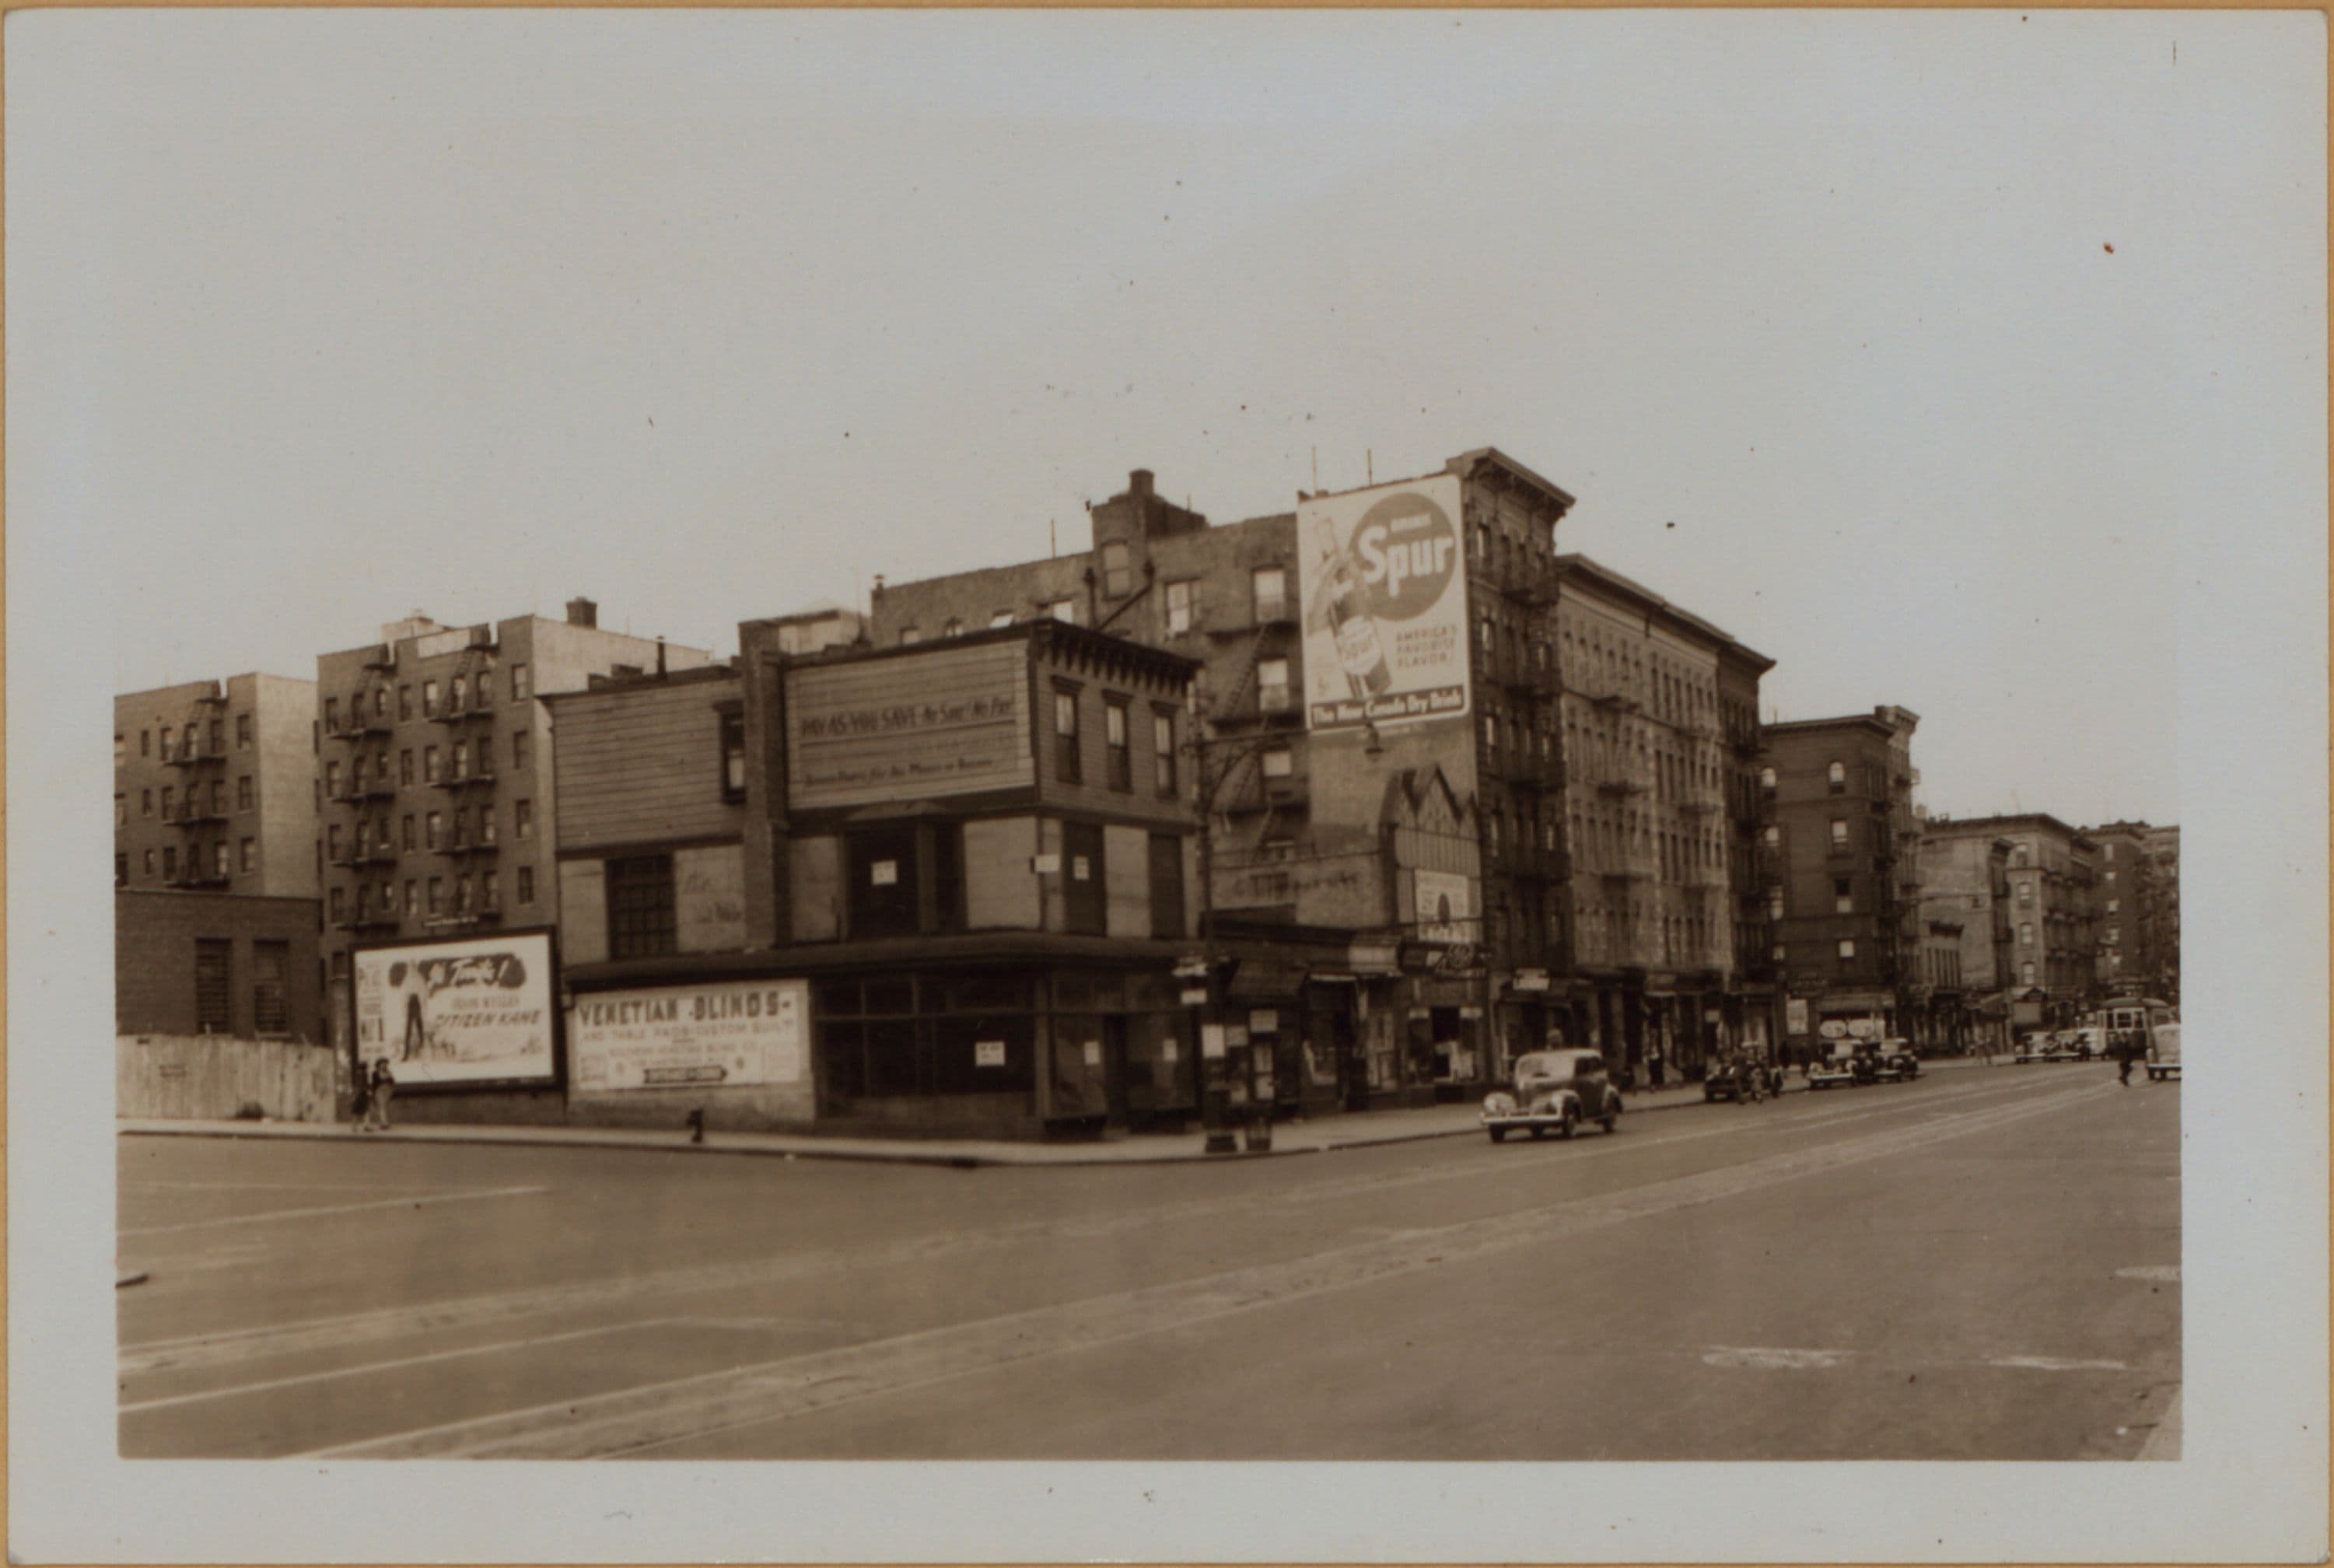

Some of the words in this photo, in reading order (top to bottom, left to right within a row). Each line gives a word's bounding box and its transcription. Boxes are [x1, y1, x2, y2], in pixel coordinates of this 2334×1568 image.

[1358, 525, 1454, 598] Spur
[827, 715, 847, 735] AS
[881, 705, 916, 729] SAVE
[1313, 705, 1335, 724] The
[1336, 702, 1363, 721] New
[1366, 698, 1406, 716] Canada
[1407, 694, 1429, 713] Dry
[435, 1012, 495, 1028] CITIZEN
[498, 1010, 541, 1026] KANE
[579, 999, 677, 1027] VENETIAN
